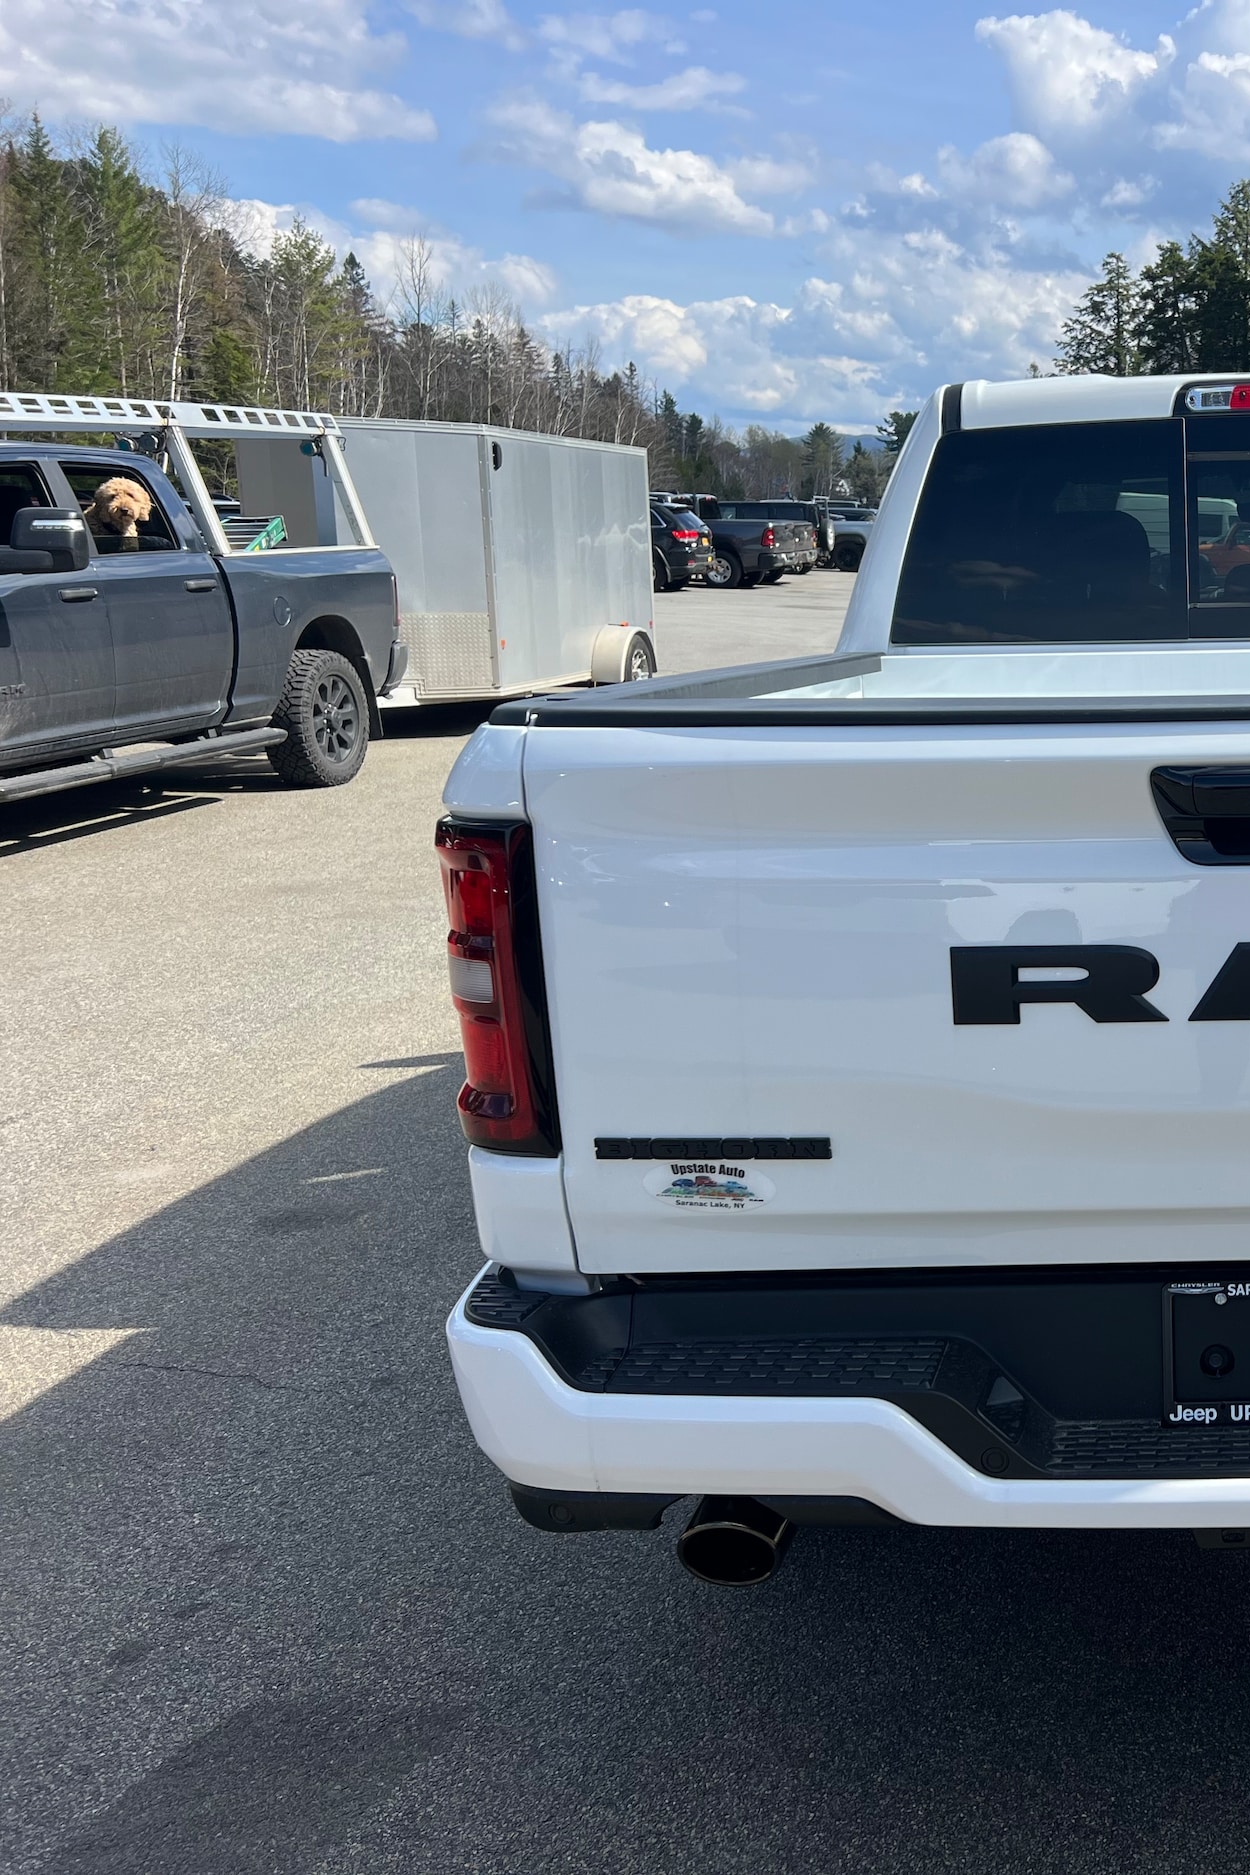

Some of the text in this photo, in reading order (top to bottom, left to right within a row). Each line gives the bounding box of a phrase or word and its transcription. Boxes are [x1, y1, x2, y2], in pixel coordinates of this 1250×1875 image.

[670, 1163, 745, 1179] Upstate Auto
[675, 1199, 708, 1207] Saranac
[710, 1200, 731, 1209] Lake,
[1169, 1404, 1217, 1424] Jeep
